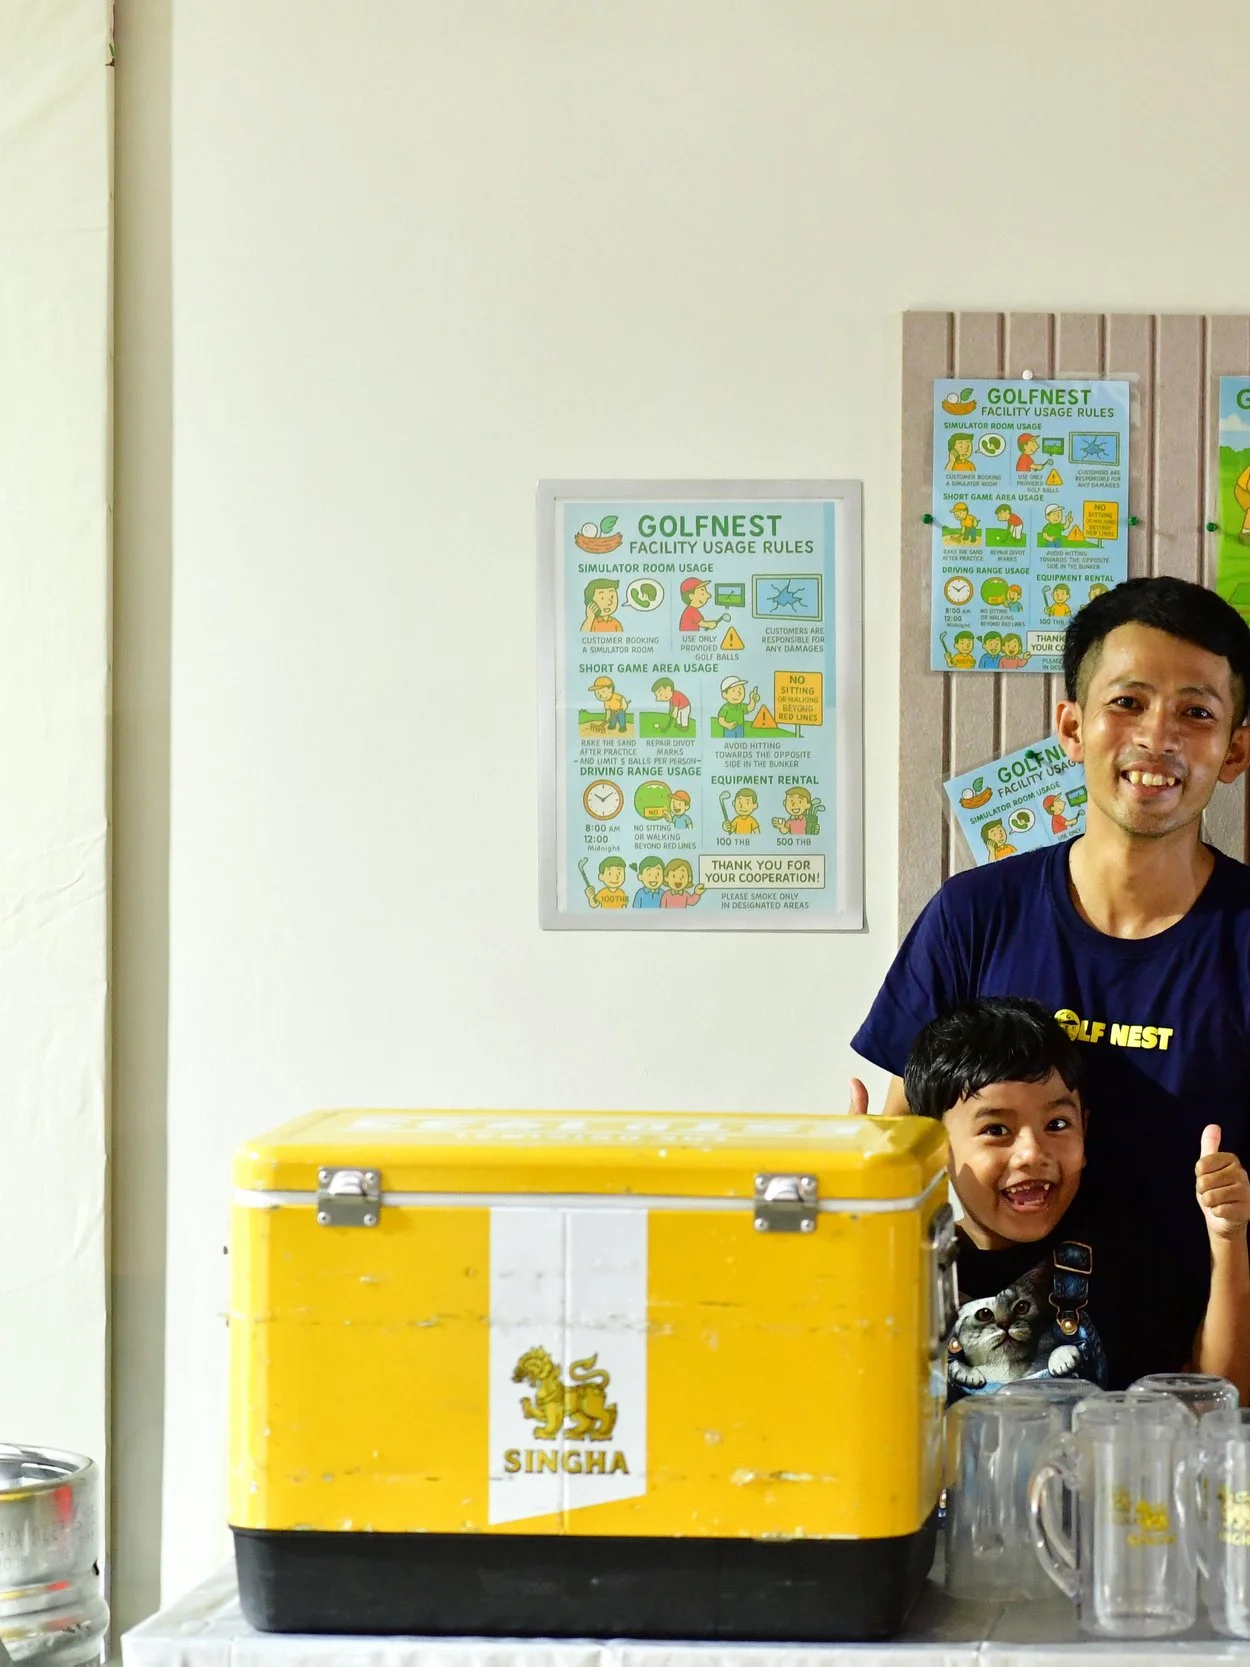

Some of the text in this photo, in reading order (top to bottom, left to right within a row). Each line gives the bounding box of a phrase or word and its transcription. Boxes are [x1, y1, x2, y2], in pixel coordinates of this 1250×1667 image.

[987, 388, 1091, 405] GOLFNEST
[981, 407, 1114, 417] FACILITY USAGE RULES
[637, 515, 782, 538] GOLFNEST
[629, 541, 814, 554] FACILITY USAGE RULES
[578, 563, 714, 573] SIMULATOR ROOM USAGE
[1036, 574, 1082, 582] EQUIPMENT
[765, 627, 824, 635] CUSTOMERS ARE
[761, 636, 825, 644] RESPONSIBLE FOR
[765, 645, 824, 653] ANY DAMAGES
[578, 663, 719, 673] SHORT GAME AREA USAGE
[580, 767, 701, 776] DRIVING RANGE USAGE
[711, 775, 819, 786] EQUIPMENT RENTAL
[997, 760, 1084, 797] FACILITY USAG
[970, 781, 1060, 825] SIMULATOR ROOM USAGE
[585, 824, 606, 832] 8:00
[1069, 828, 1082, 837] ONLY
[584, 835, 608, 843] 12:00
[716, 837, 750, 846] 100 THB
[776, 837, 812, 846] 500 THB
[587, 844, 620, 853] Midnight
[712, 860, 811, 870] THANK YOU FOR
[705, 872, 820, 883] YOUR COOPERATION!
[721, 893, 748, 901] PLEASE
[780, 892, 799, 900] ONLY
[732, 902, 780, 910] DESIGNATED
[783, 901, 809, 909] AREAS
[1110, 1023, 1173, 1050] NEST
[504, 1449, 630, 1474] SINGHA
